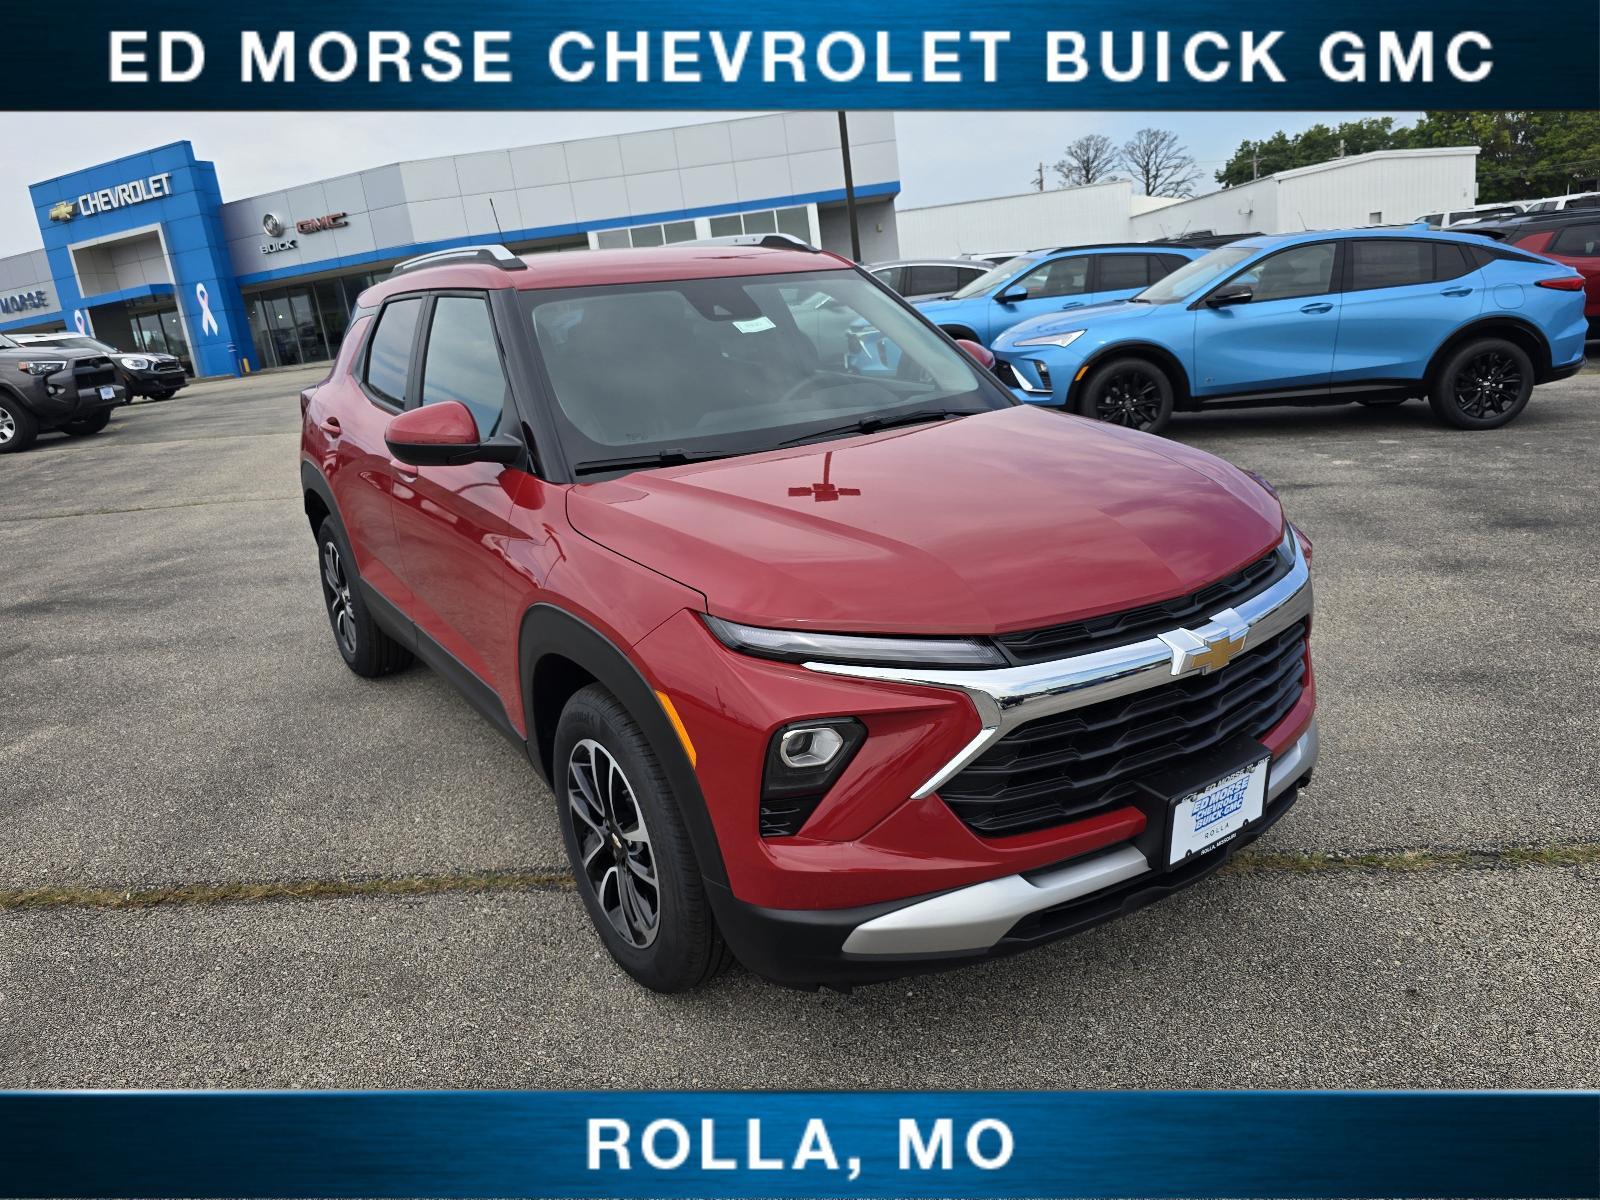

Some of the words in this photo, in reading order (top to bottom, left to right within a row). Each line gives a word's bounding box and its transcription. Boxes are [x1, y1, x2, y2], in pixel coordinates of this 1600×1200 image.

[78, 172, 170, 216] CHEVROLET
[296, 213, 348, 235] GMC
[260, 240, 298, 255] BUICK
[1192, 796, 1211, 815] ED
[1210, 776, 1250, 805] MORSE
[1196, 793, 1245, 821] CHEVROLET
